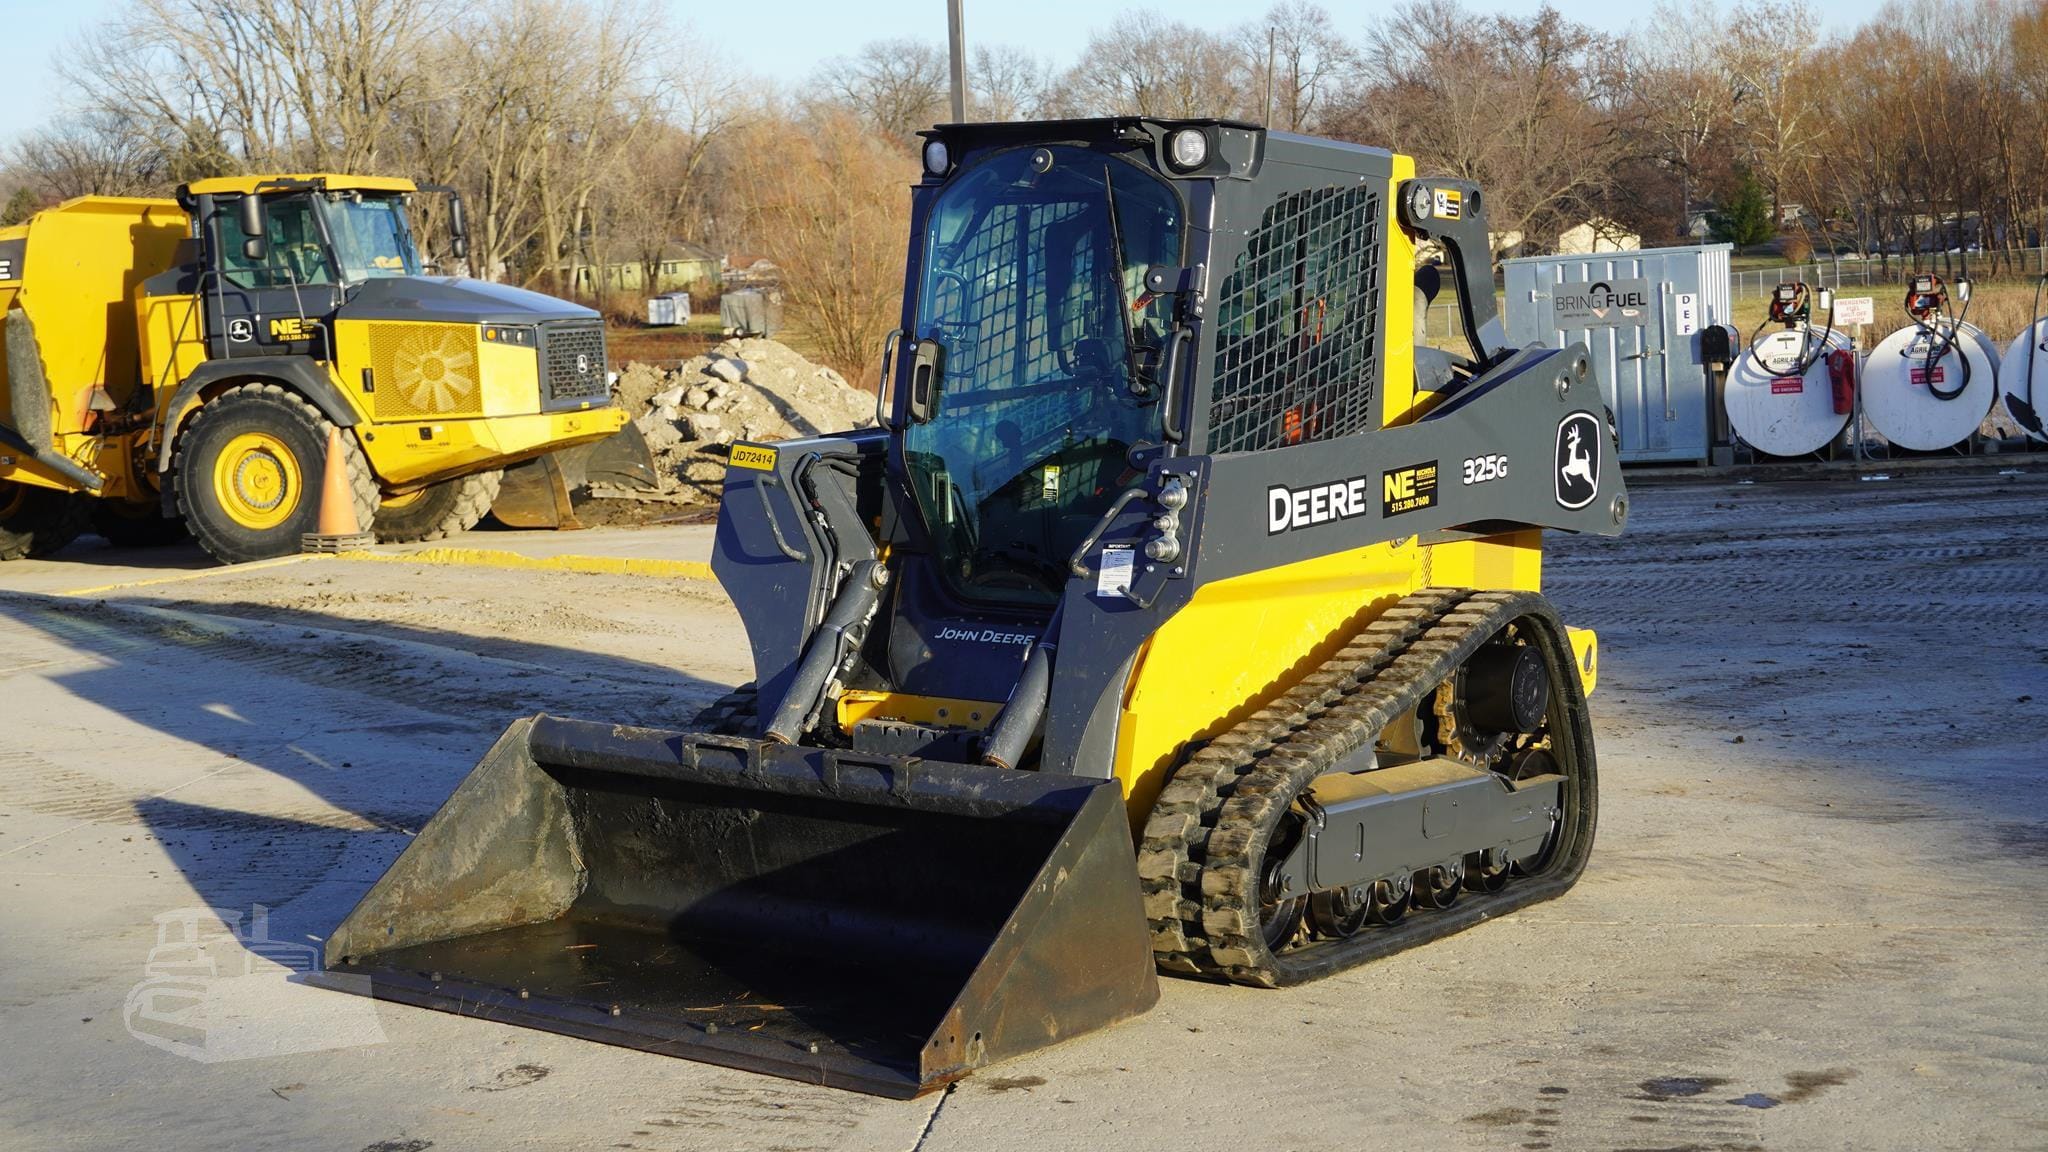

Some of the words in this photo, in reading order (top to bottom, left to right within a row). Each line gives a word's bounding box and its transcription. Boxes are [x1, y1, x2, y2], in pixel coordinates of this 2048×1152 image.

[1556, 294, 1601, 311] BRING
[1606, 292, 1647, 308] FUEL
[269, 318, 302, 336] NE
[733, 450, 773, 464] JD72414
[1463, 454, 1508, 485] 325G
[1384, 469, 1416, 503] NE
[1268, 477, 1366, 534] DEERE
[1391, 495, 1430, 513] 515.280.7600
[934, 627, 979, 641] JOHN
[980, 630, 1036, 645] DEERE
